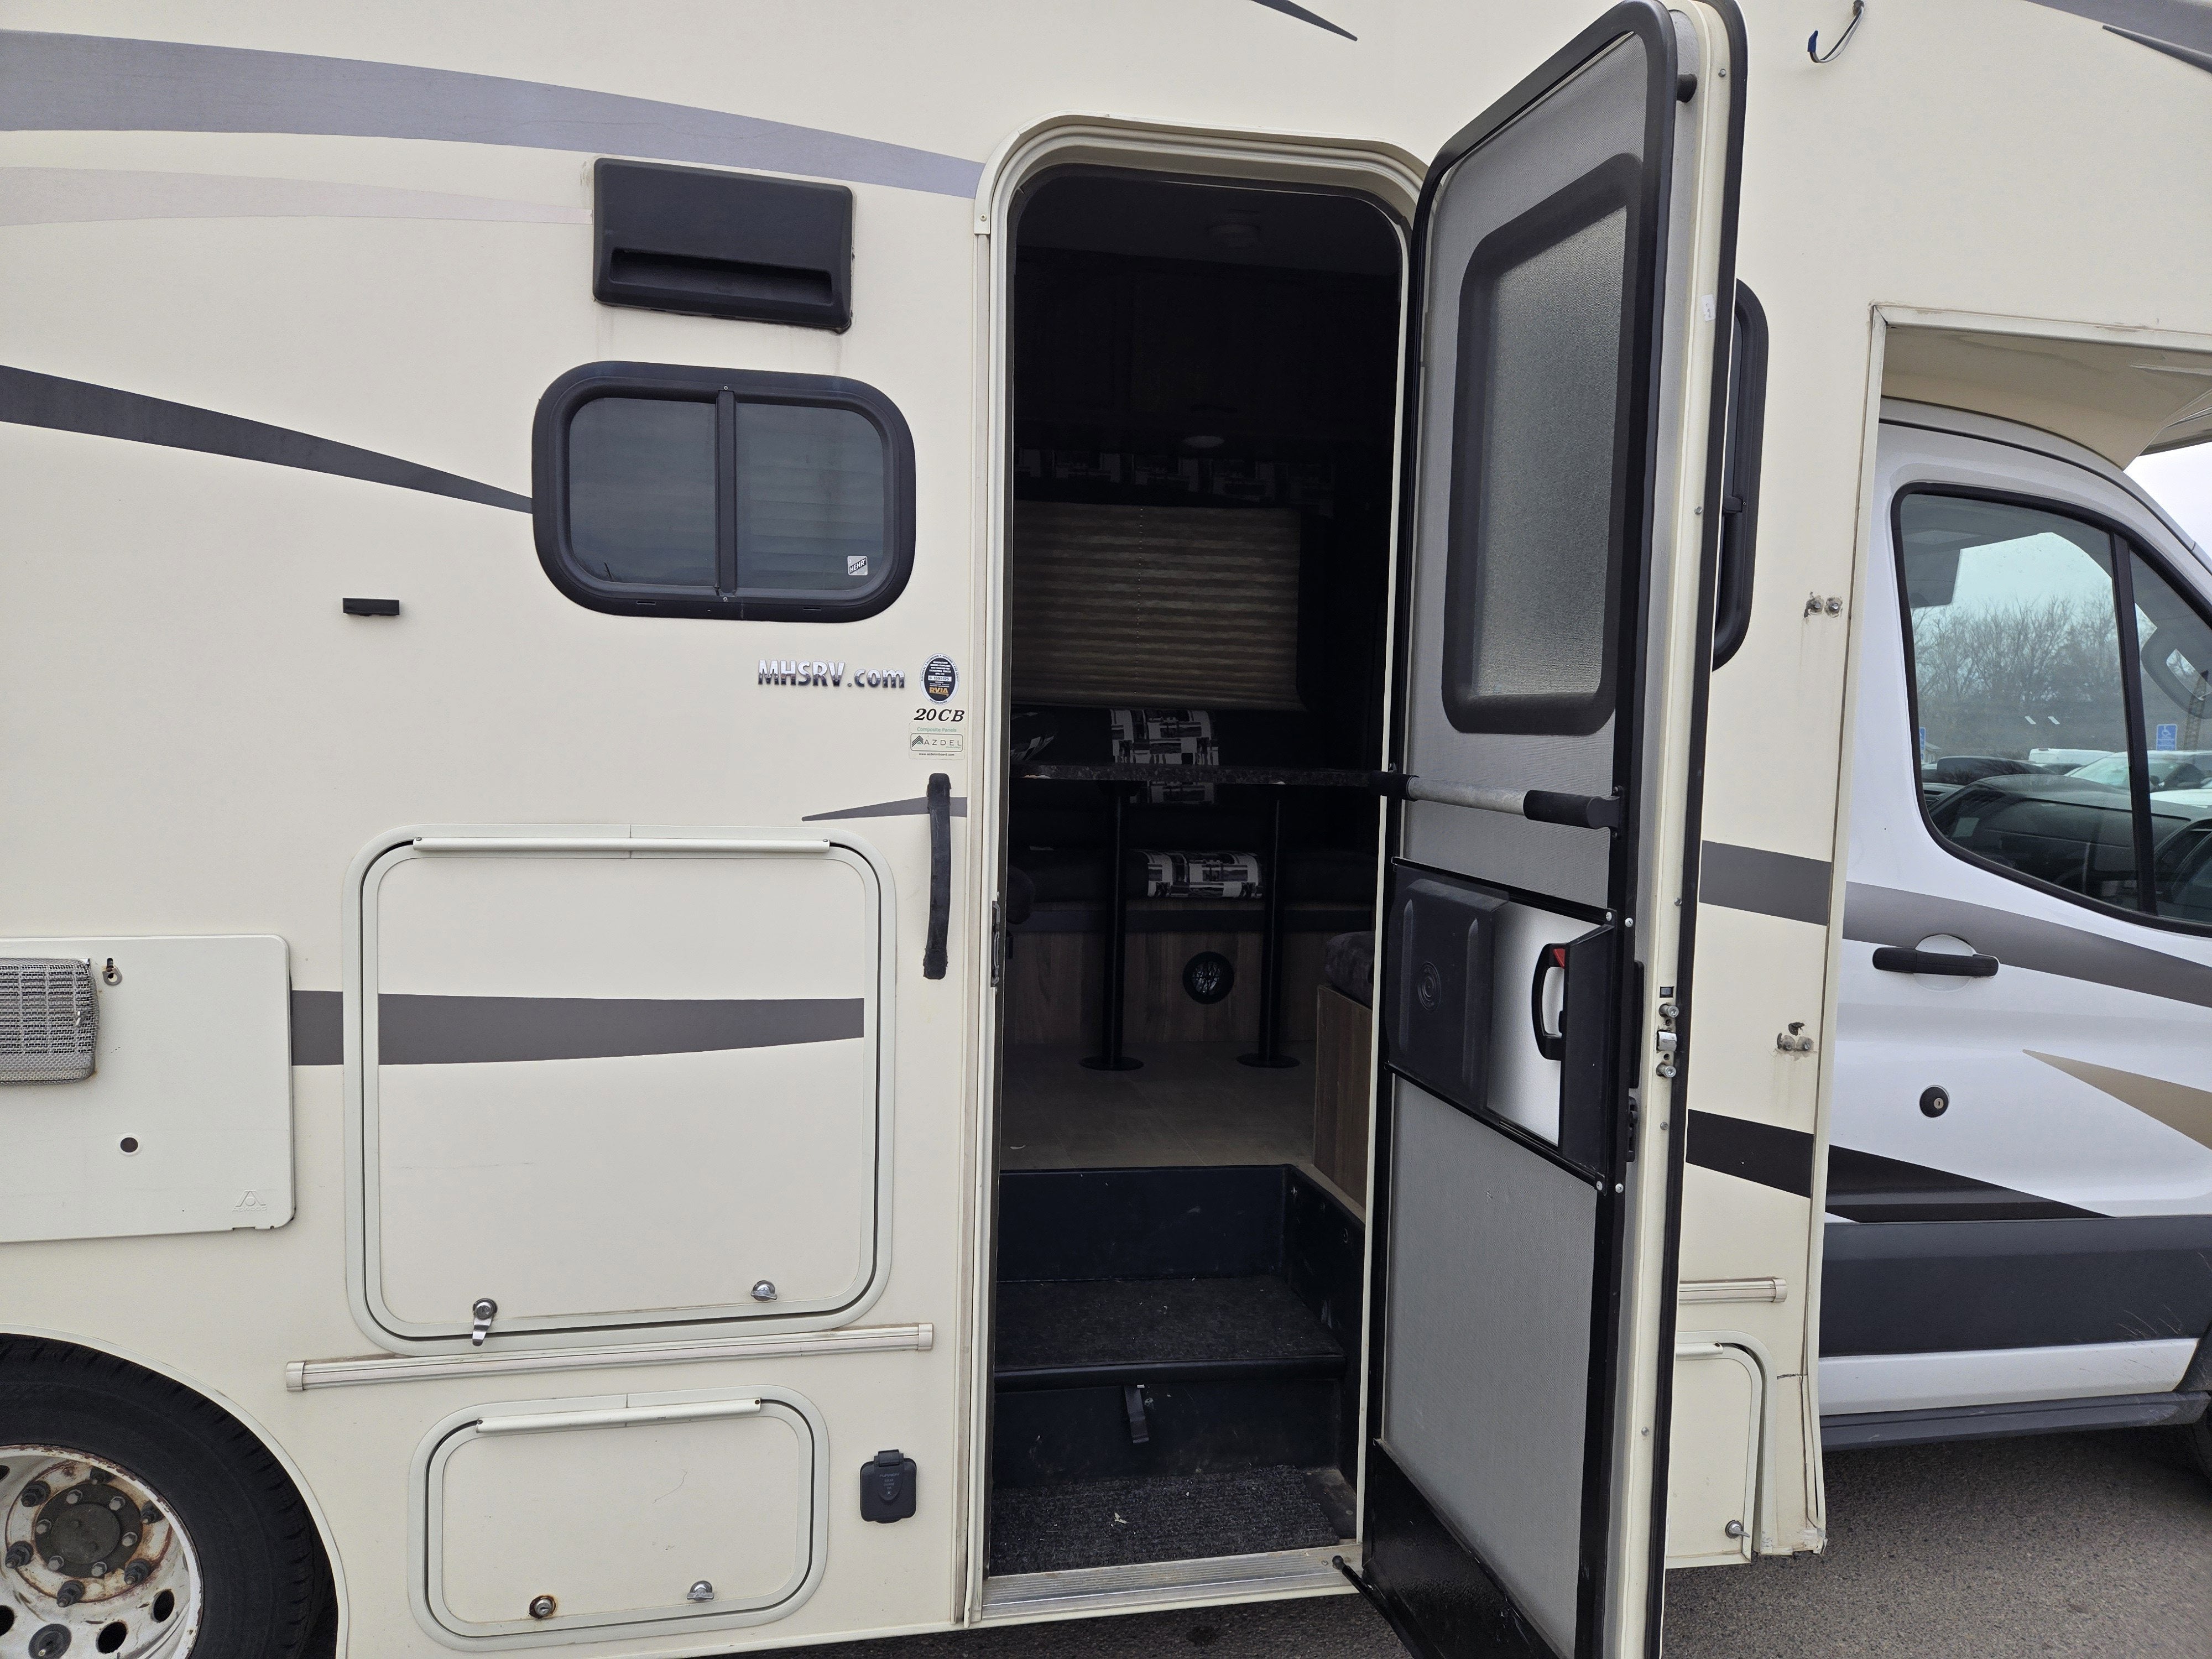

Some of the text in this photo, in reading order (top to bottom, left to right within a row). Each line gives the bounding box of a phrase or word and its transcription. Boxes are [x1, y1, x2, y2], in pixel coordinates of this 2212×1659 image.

[849, 560, 865, 573] HEHR
[758, 660, 905, 688] MHSRV.com
[914, 708, 965, 722] 20CB
